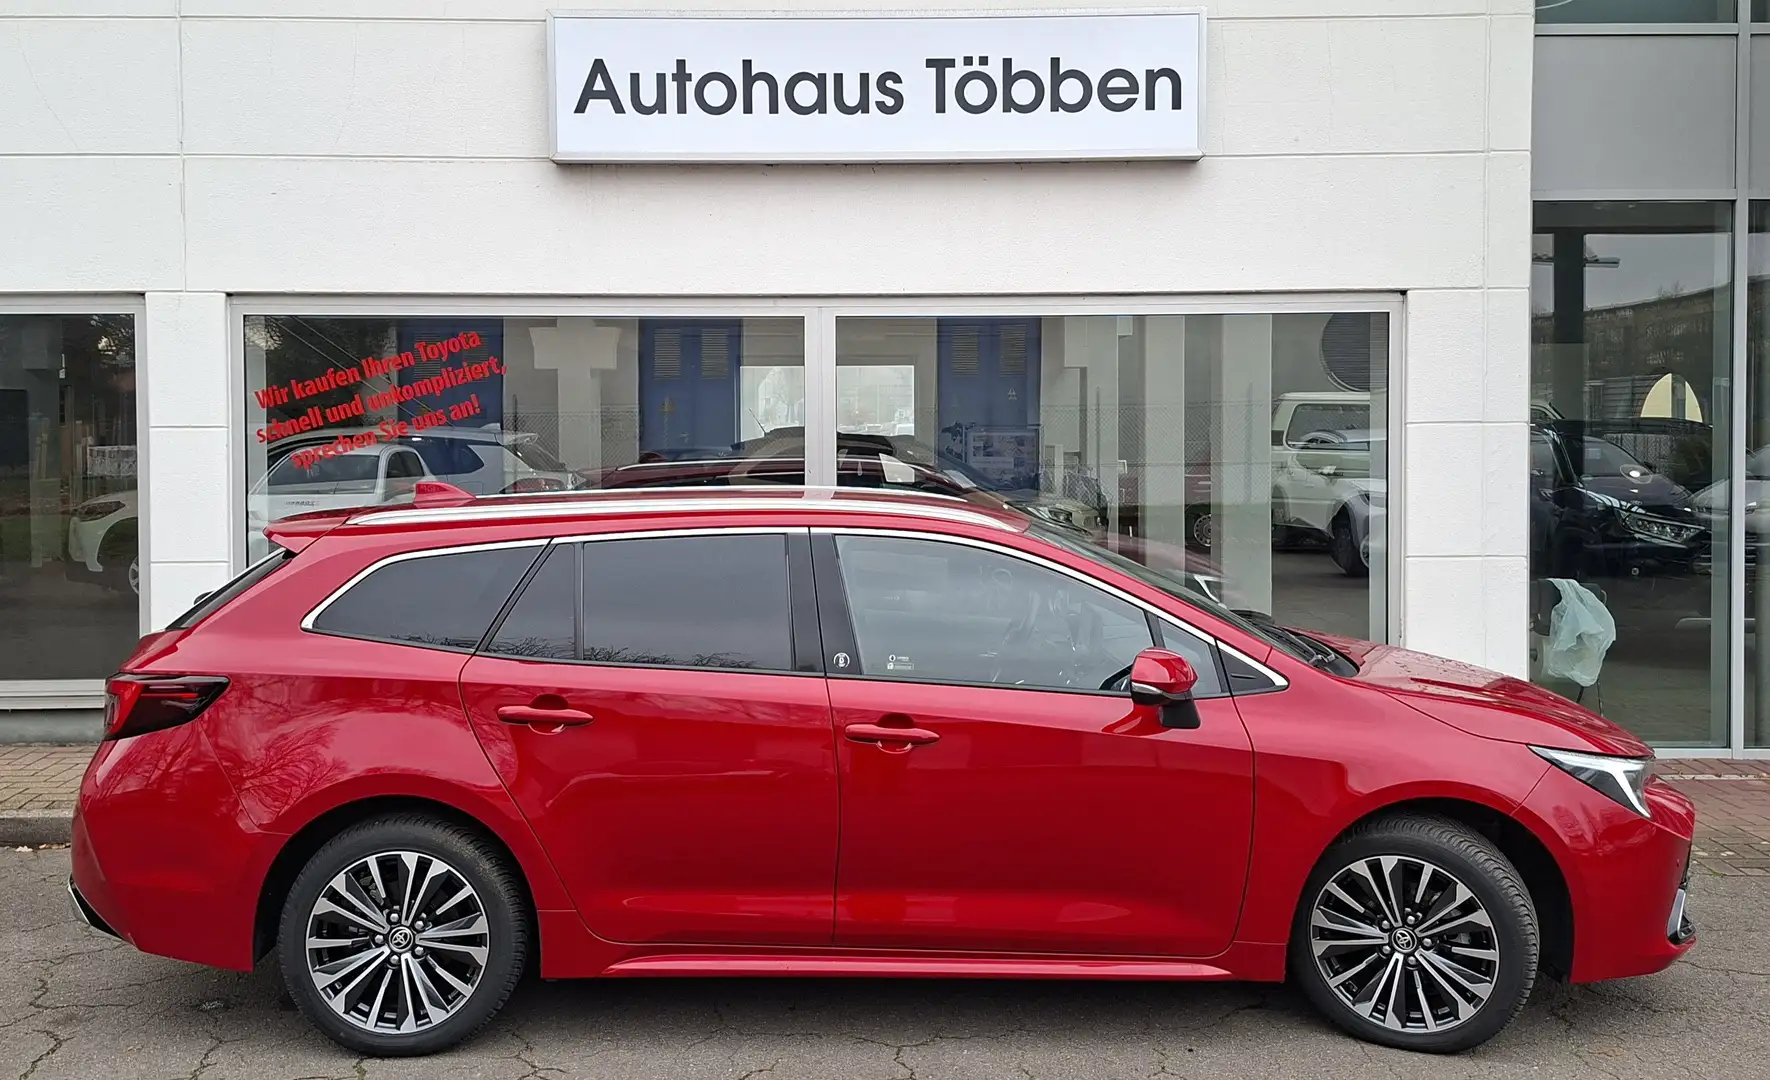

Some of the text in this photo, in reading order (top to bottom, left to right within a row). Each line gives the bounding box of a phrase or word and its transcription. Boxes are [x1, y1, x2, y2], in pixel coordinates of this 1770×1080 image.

[574, 55, 1183, 116] Autohaus Többen
[254, 331, 481, 409] Wir kaufen Ihren Toyota
[257, 355, 507, 443] schnell und unkompliziert,
[291, 394, 481, 469] sprechen Sie uns an!
